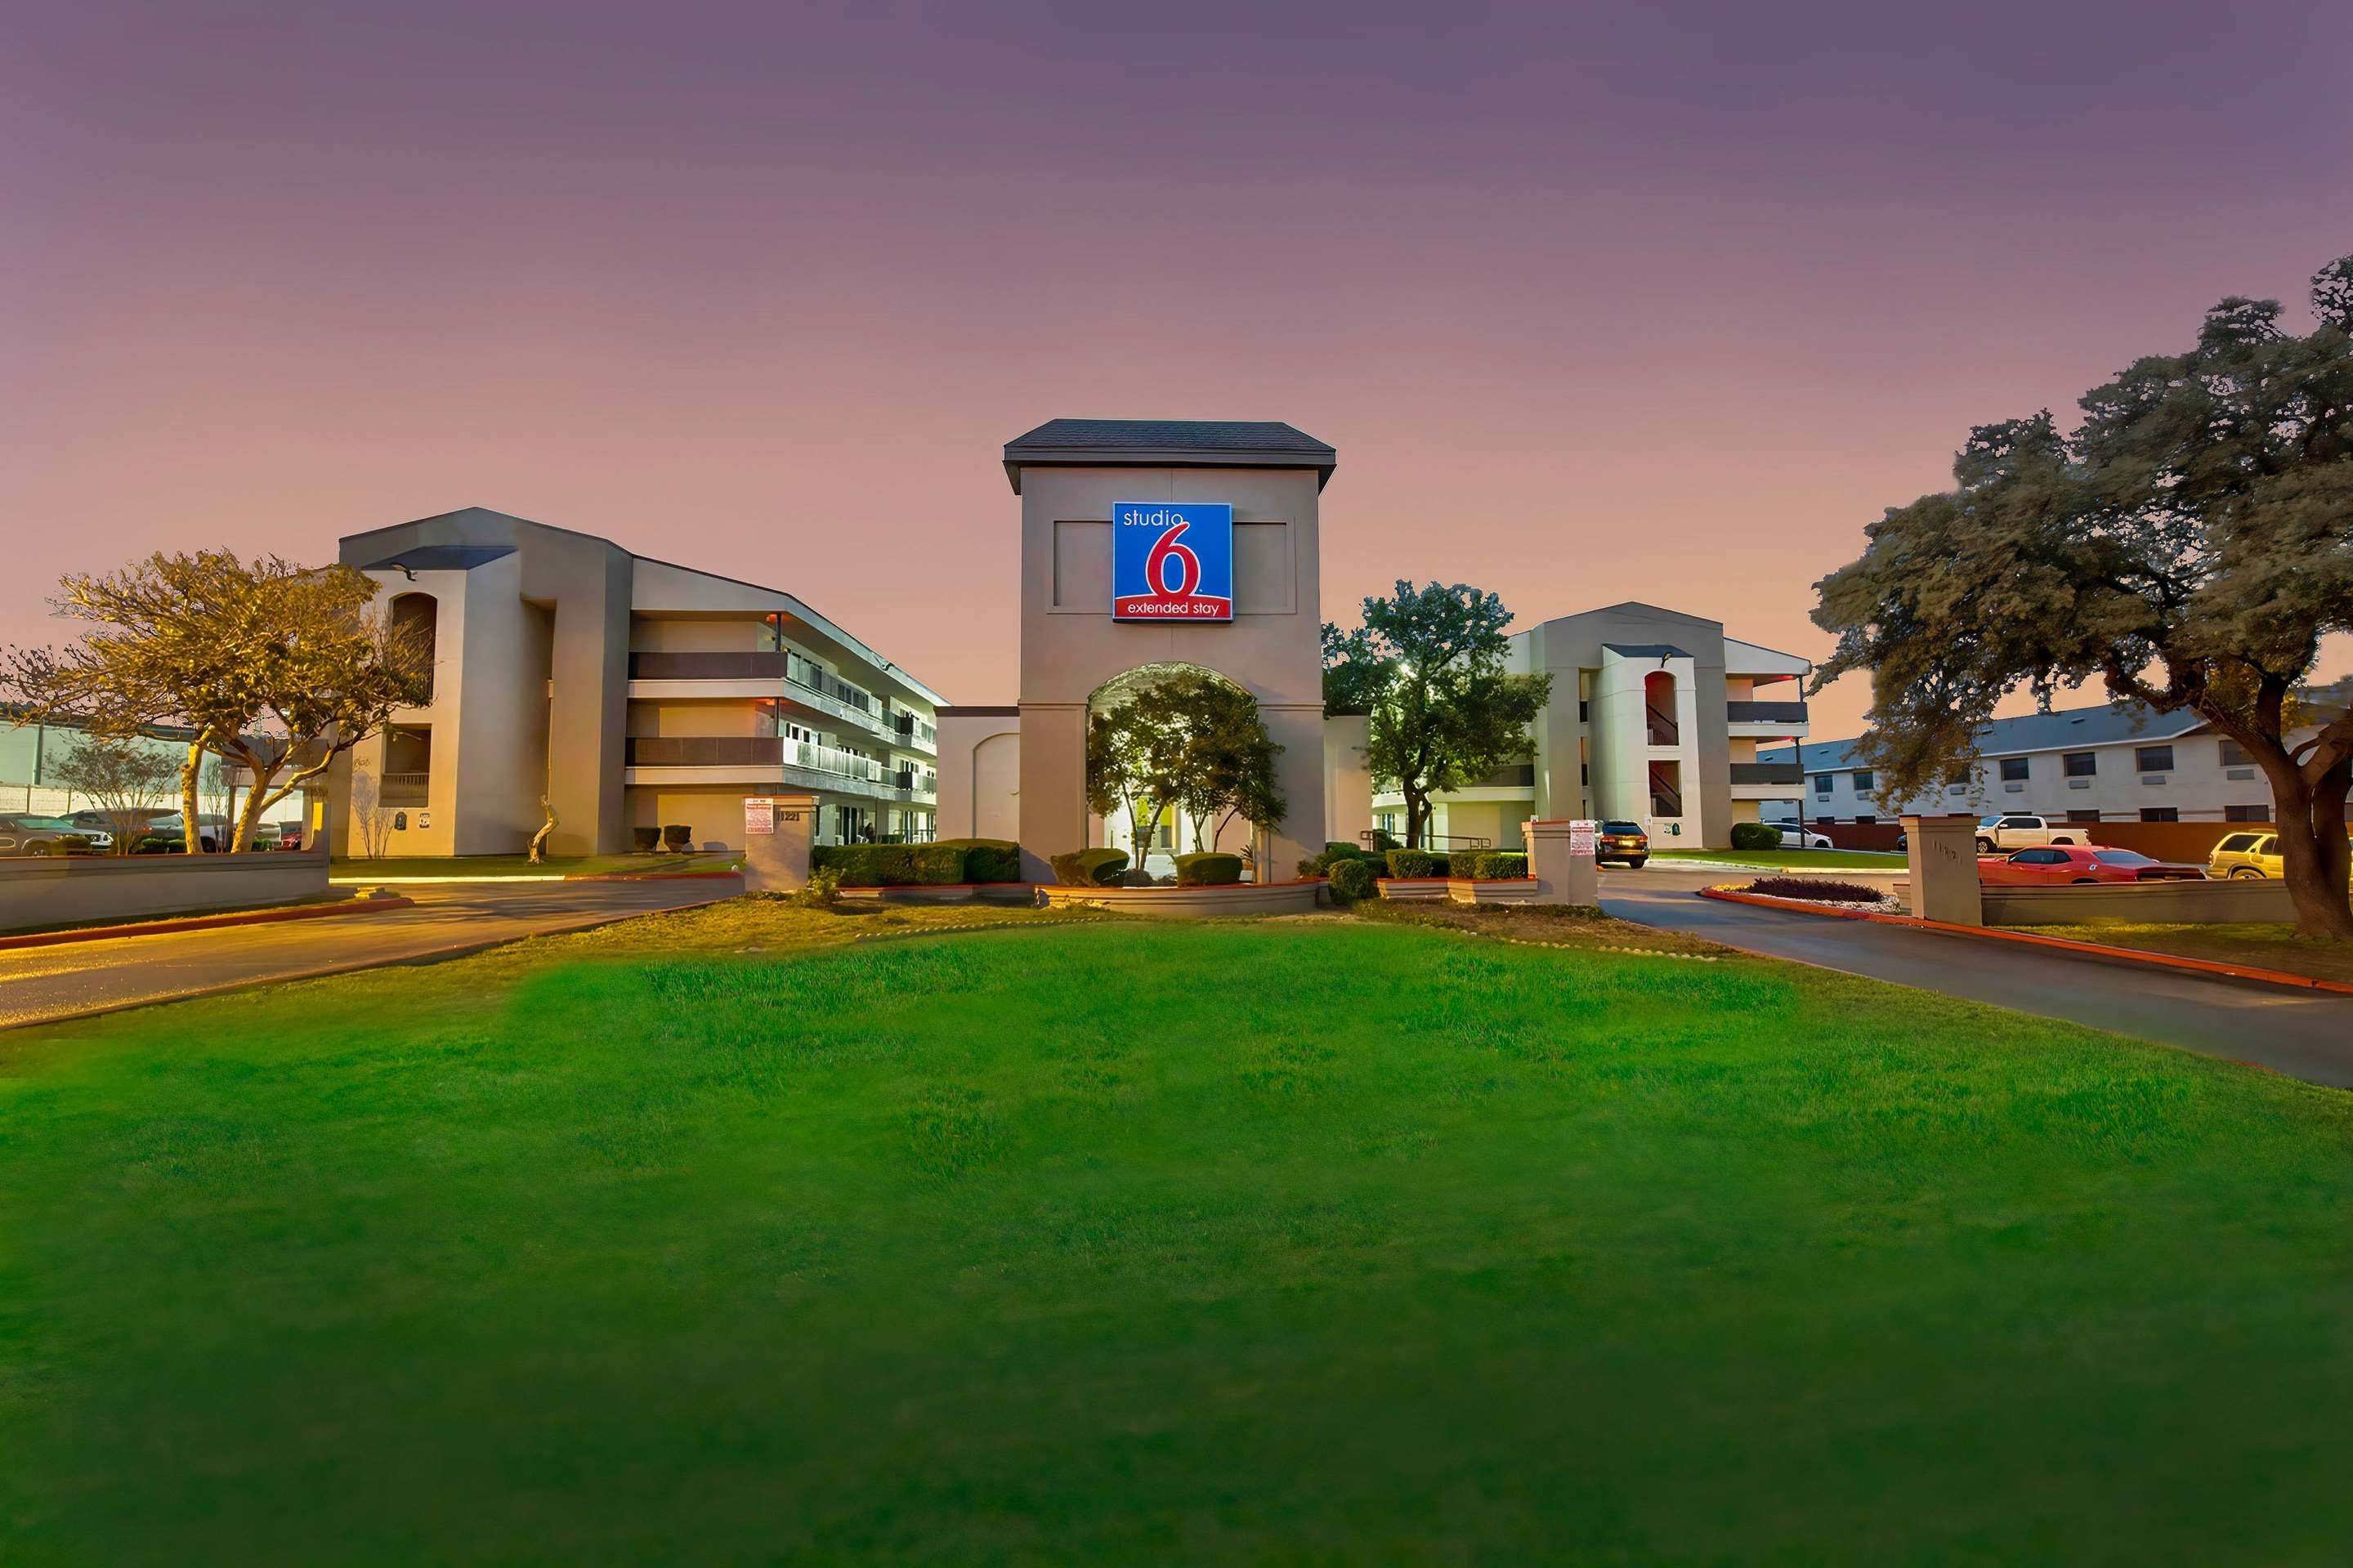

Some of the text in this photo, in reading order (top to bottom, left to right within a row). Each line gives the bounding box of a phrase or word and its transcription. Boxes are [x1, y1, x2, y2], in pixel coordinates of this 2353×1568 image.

[1124, 510, 1184, 526] studio
[1145, 521, 1201, 598] 6
[1127, 601, 1220, 616] extended stay
